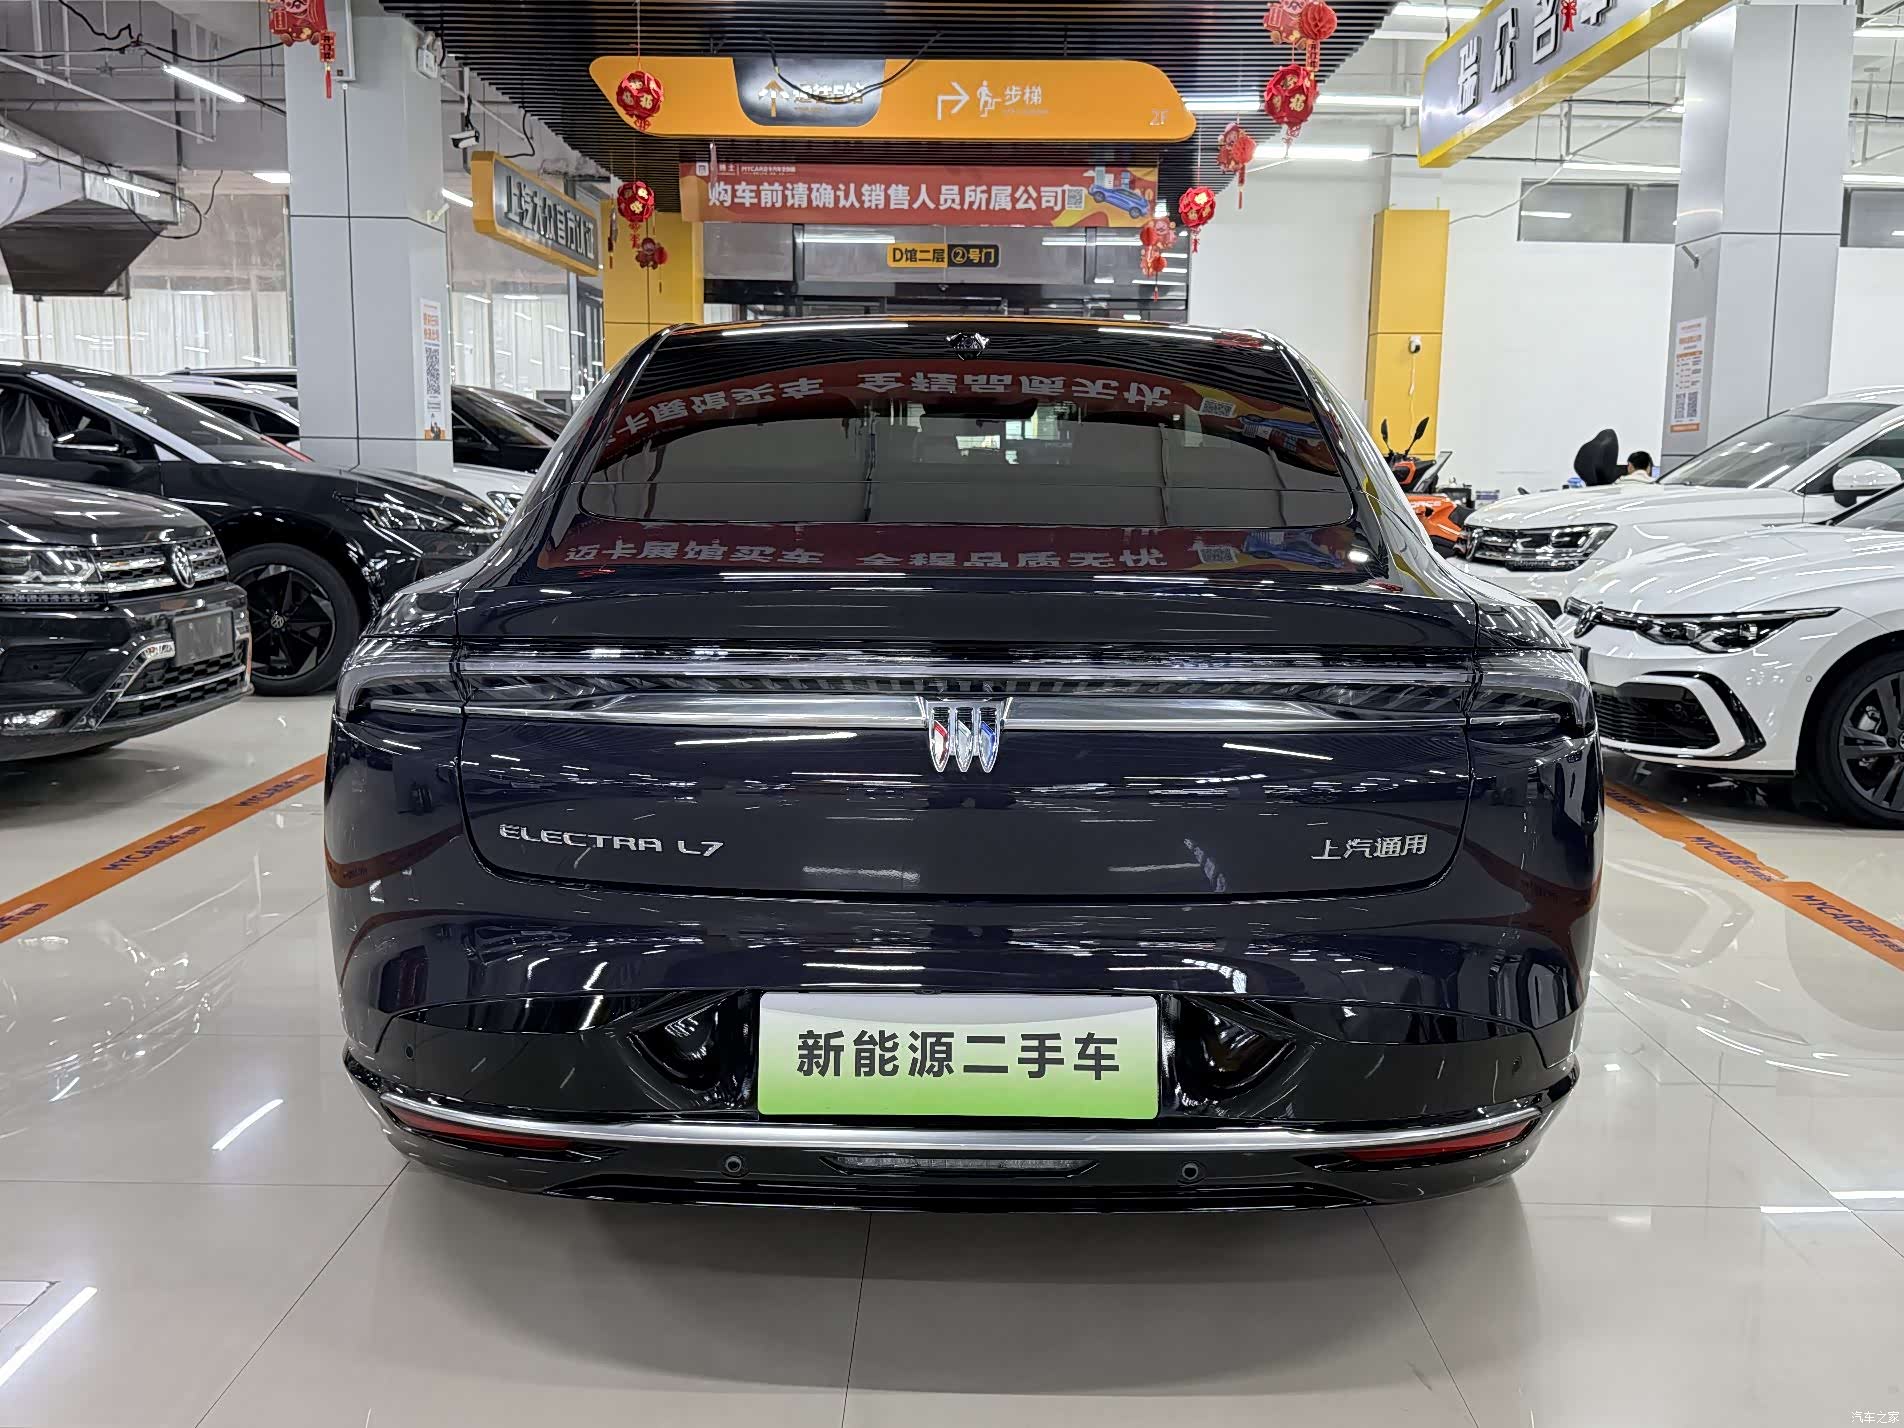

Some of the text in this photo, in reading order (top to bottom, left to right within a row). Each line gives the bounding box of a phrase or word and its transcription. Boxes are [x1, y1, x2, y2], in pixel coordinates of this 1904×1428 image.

[1004, 85, 1043, 105] 步梯
[1149, 110, 1169, 126] 2F
[708, 181, 1064, 212] 购车前请确认销售人员所属公司
[892, 247, 946, 263] D馆二层
[499, 823, 724, 857] ELECTRA L7
[1310, 833, 1428, 859] 上汽通用
[796, 1029, 1120, 1081] 新能源二手车
